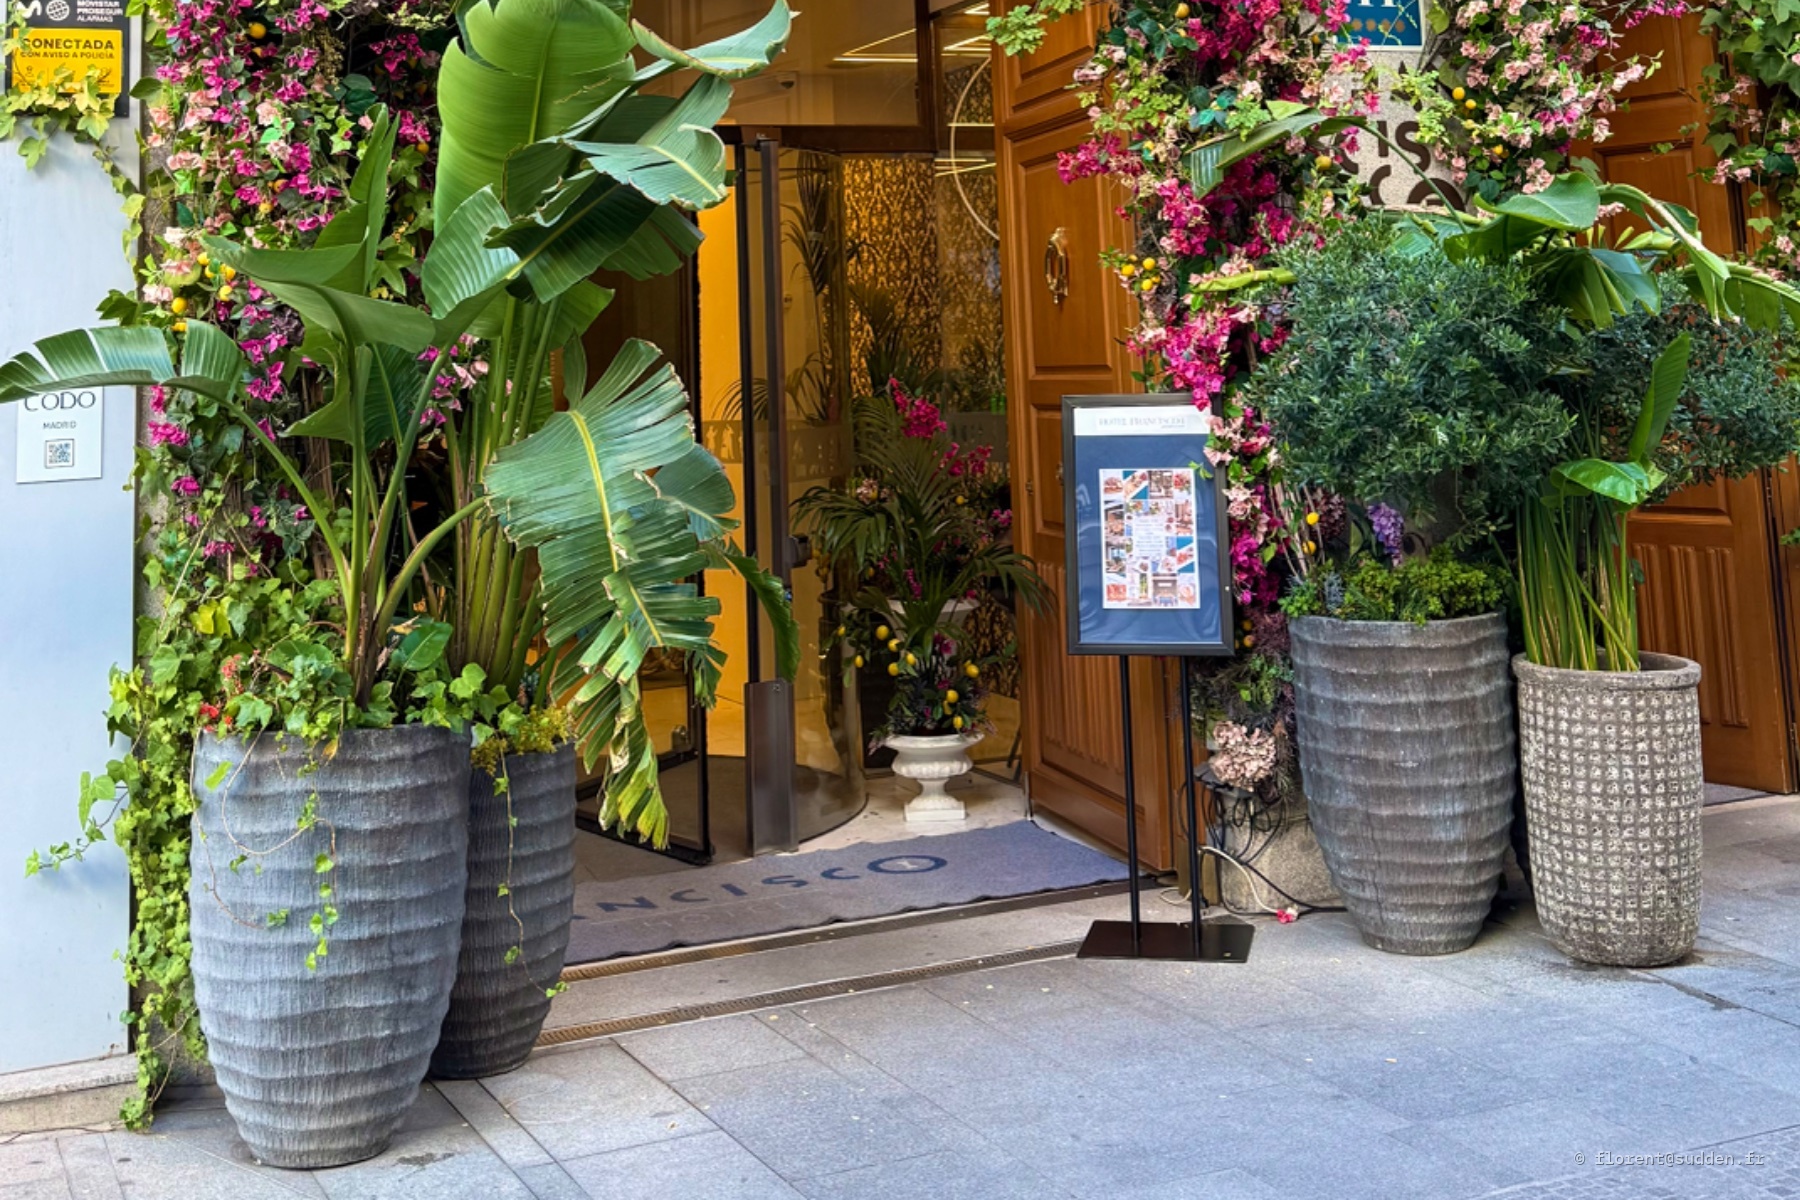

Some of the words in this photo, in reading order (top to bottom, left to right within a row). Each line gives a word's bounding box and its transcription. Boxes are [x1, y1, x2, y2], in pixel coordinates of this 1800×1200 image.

[76, 0, 120, 8] MOVISTAR
[76, 7, 124, 16] PROSEGUR
[76, 14, 114, 23] ALARMAS
[42, 420, 77, 430] MADRID
[571, 854, 948, 921] NCISCO
